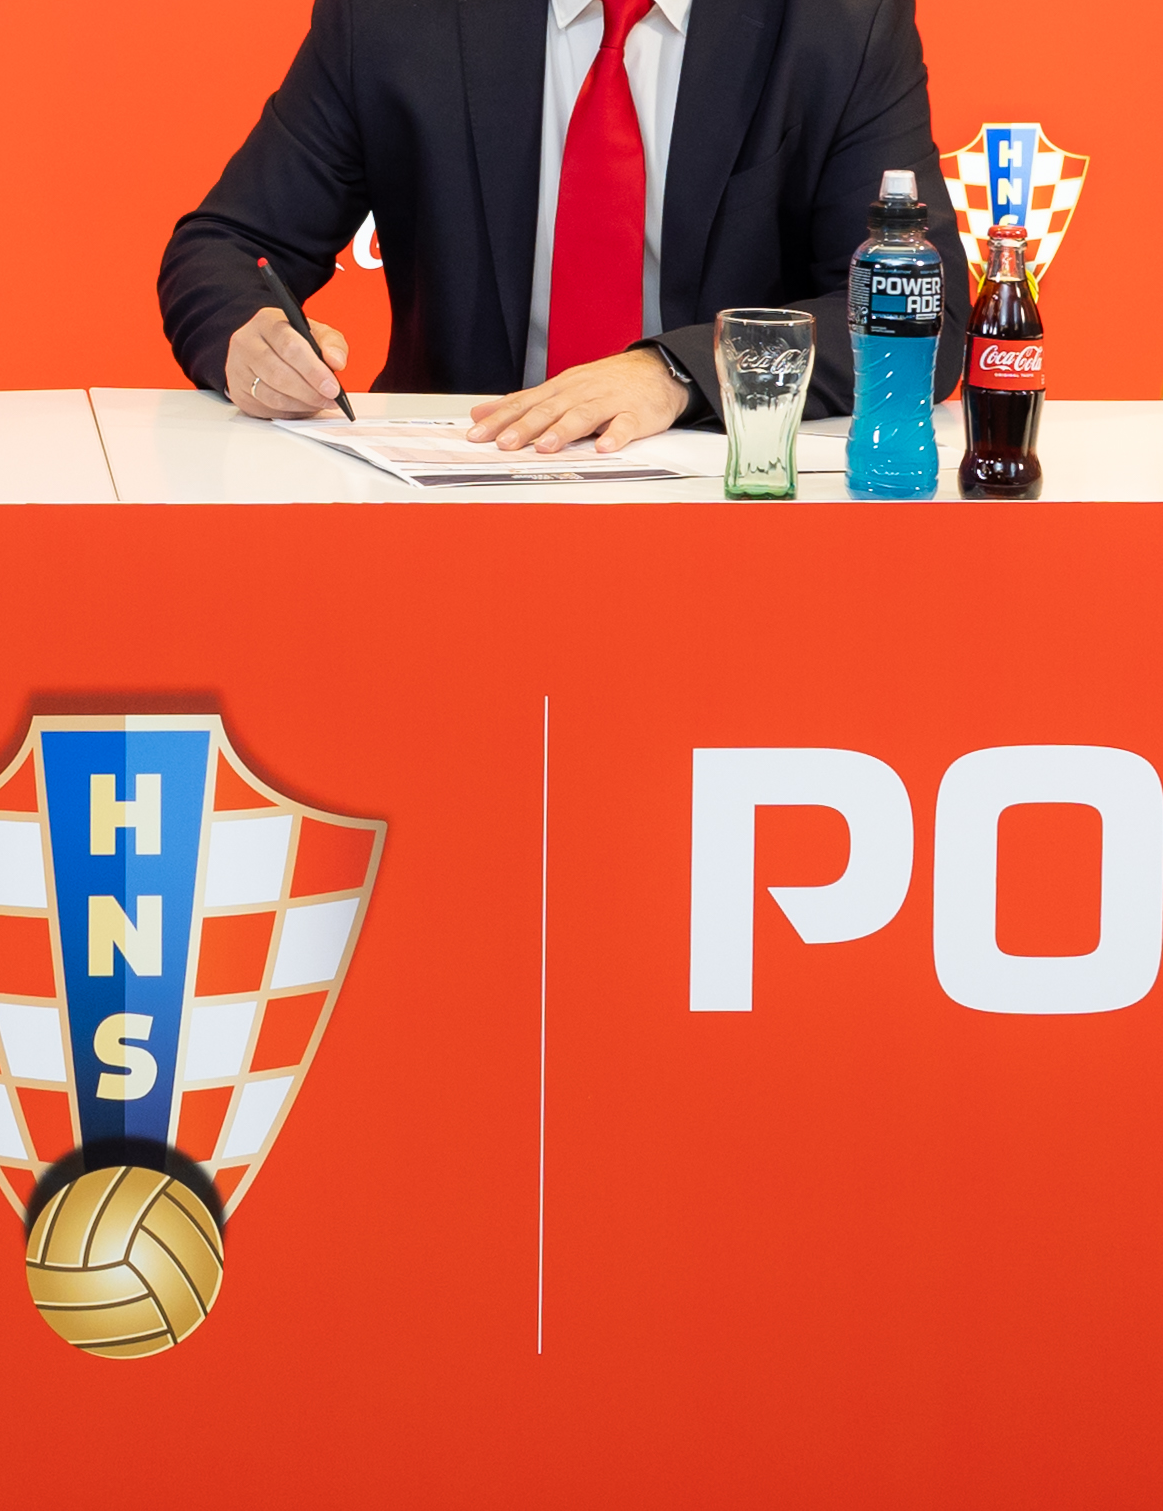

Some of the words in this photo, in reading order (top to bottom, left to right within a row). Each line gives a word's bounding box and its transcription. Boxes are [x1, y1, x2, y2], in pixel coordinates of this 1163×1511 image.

[872, 276, 941, 295] POWER
[907, 295, 941, 313] ADE
[979, 345, 1043, 371] Coca-Cola
[89, 773, 163, 1102] HNS
